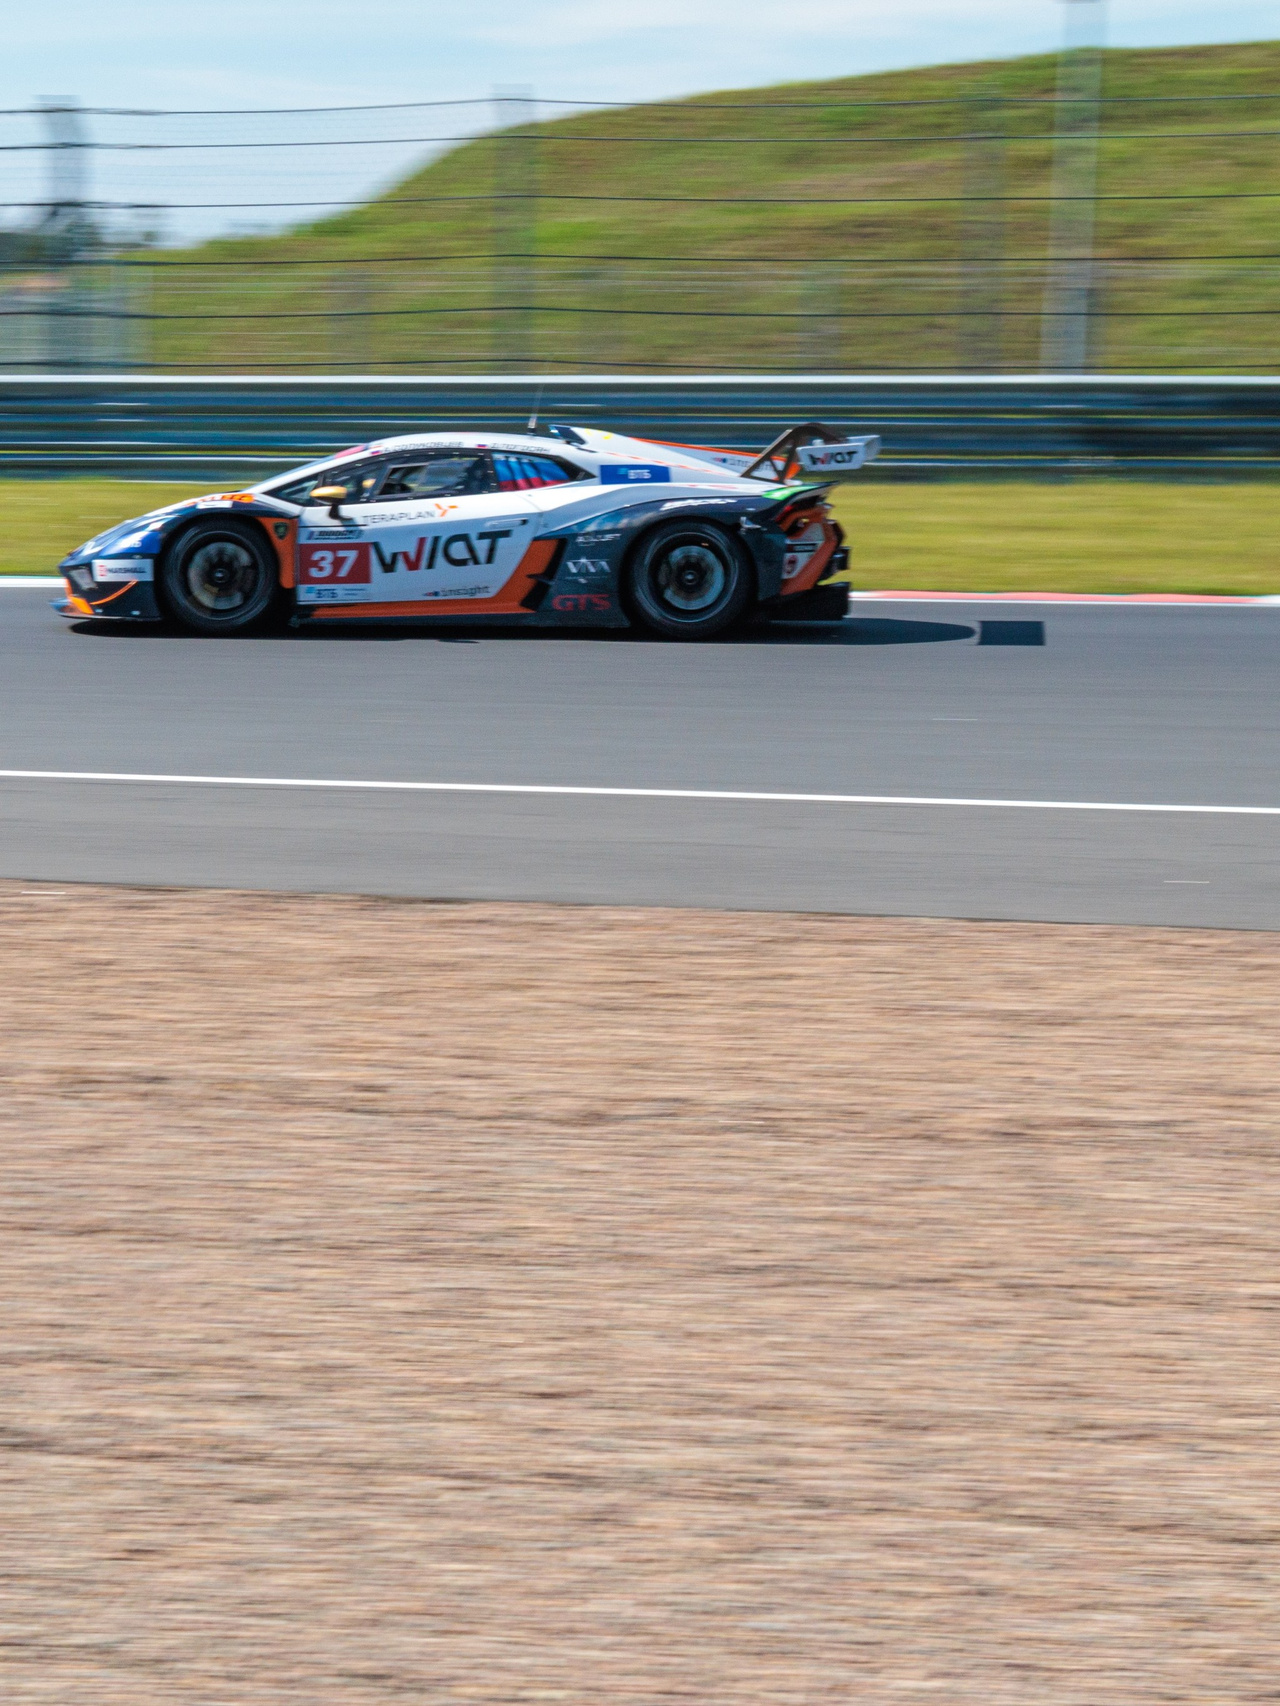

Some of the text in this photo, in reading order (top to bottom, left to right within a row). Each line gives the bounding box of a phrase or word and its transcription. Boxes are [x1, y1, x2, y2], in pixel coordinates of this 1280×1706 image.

[361, 510, 436, 525] TERAPLAN
[308, 549, 359, 578] 37
[552, 593, 612, 611] GTS
